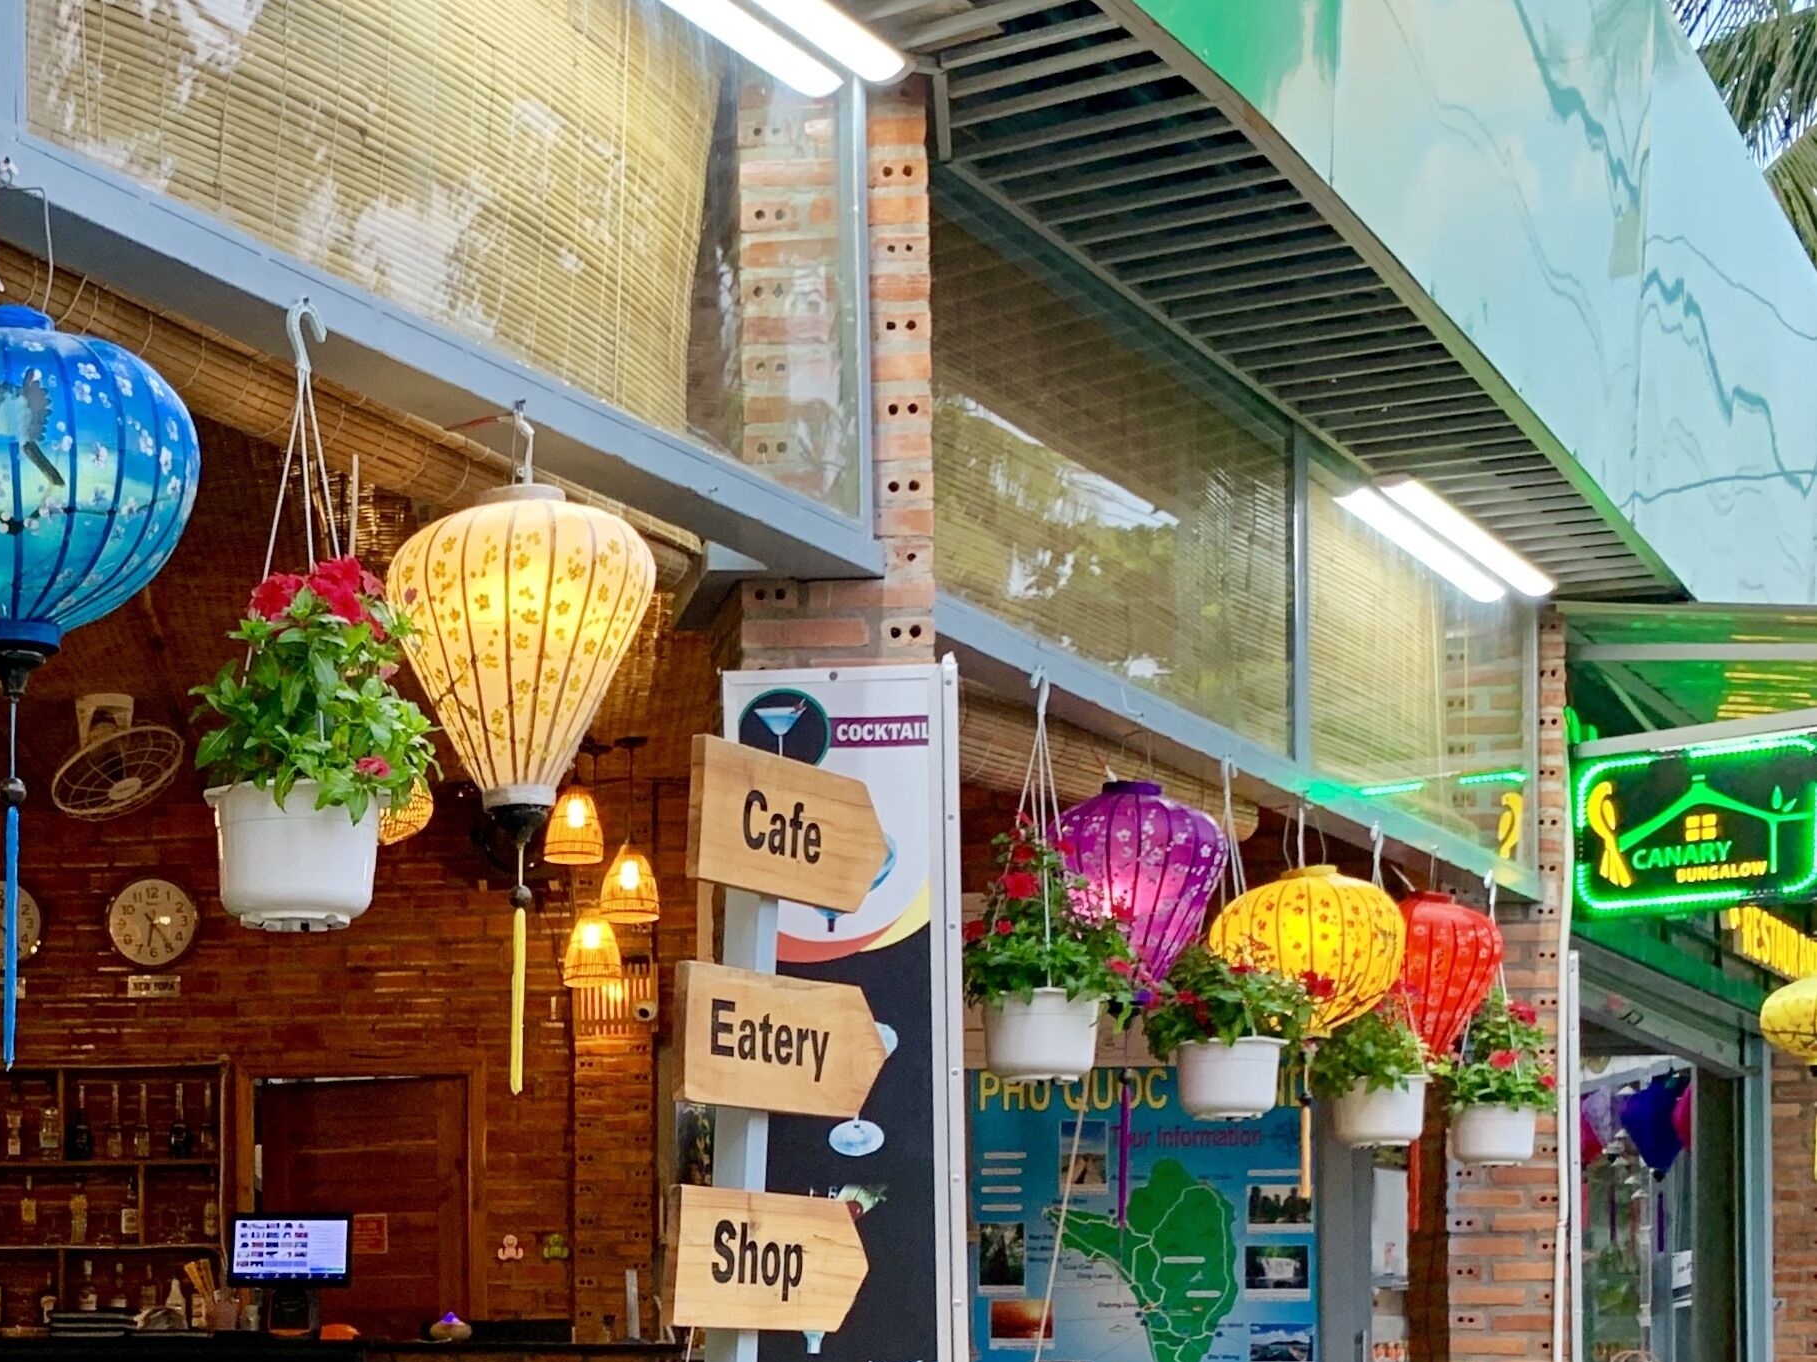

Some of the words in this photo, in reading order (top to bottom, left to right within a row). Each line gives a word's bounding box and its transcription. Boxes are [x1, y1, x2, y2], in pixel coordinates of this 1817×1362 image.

[836, 722, 929, 742] COCKTAIL
[743, 789, 822, 864] Cafe
[1632, 840, 1733, 870] CANARY
[1676, 860, 1768, 884] BUNGALOW
[710, 998, 830, 1083] Eatery
[1062, 1068, 1169, 1112] QUOC
[1111, 1124, 1150, 1147] Tur
[1157, 1124, 1262, 1147] Information
[711, 1219, 804, 1302] Shop
